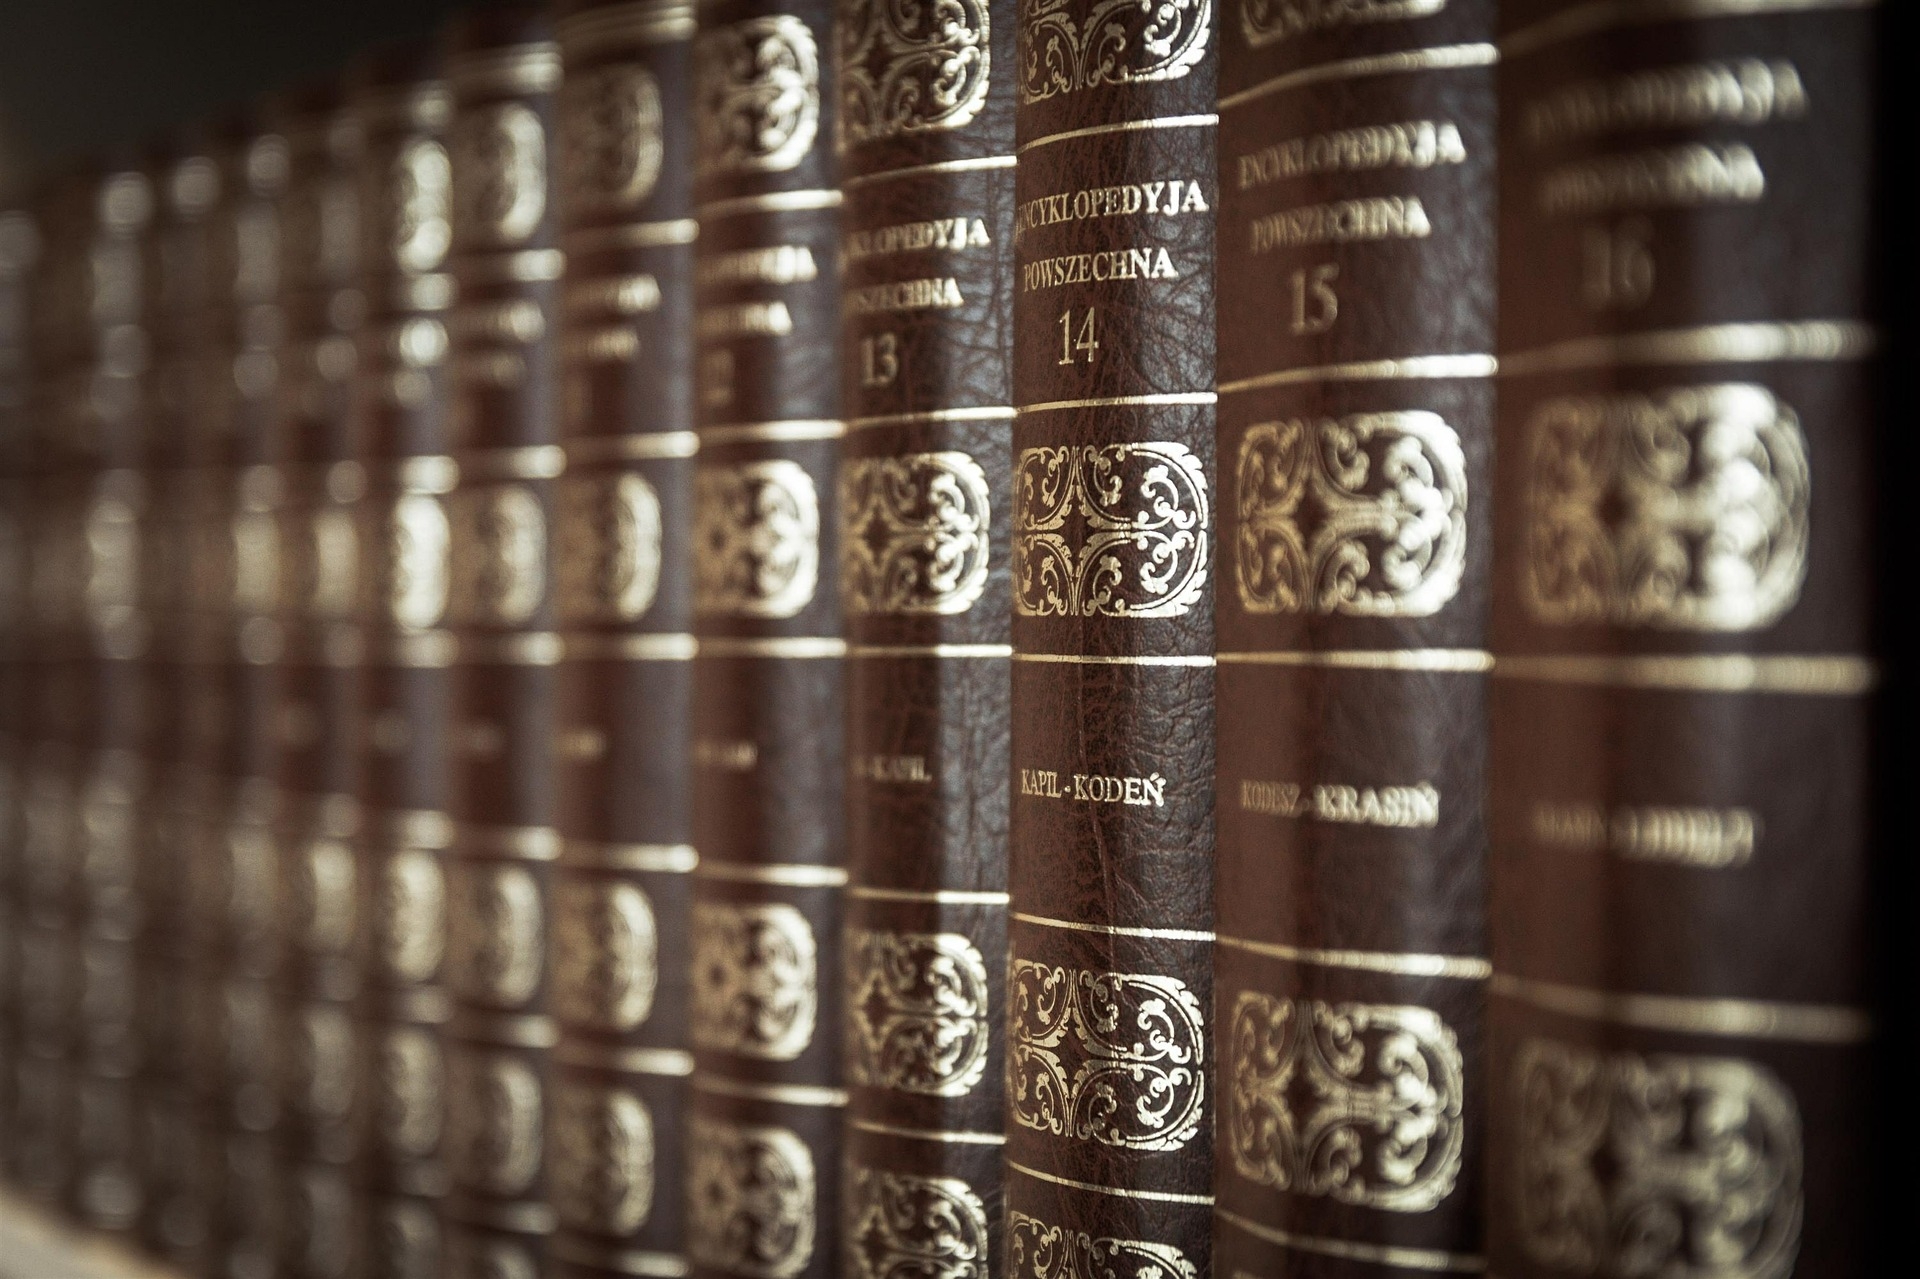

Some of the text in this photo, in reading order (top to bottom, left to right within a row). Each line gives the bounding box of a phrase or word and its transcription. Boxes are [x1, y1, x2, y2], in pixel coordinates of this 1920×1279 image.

[1024, 247, 1178, 292] POWSZECHNA
[1290, 262, 1339, 335] 15
[862, 333, 898, 386] 13
[1059, 306, 1099, 365] 14
[1074, 771, 1167, 807] KODEŃ
